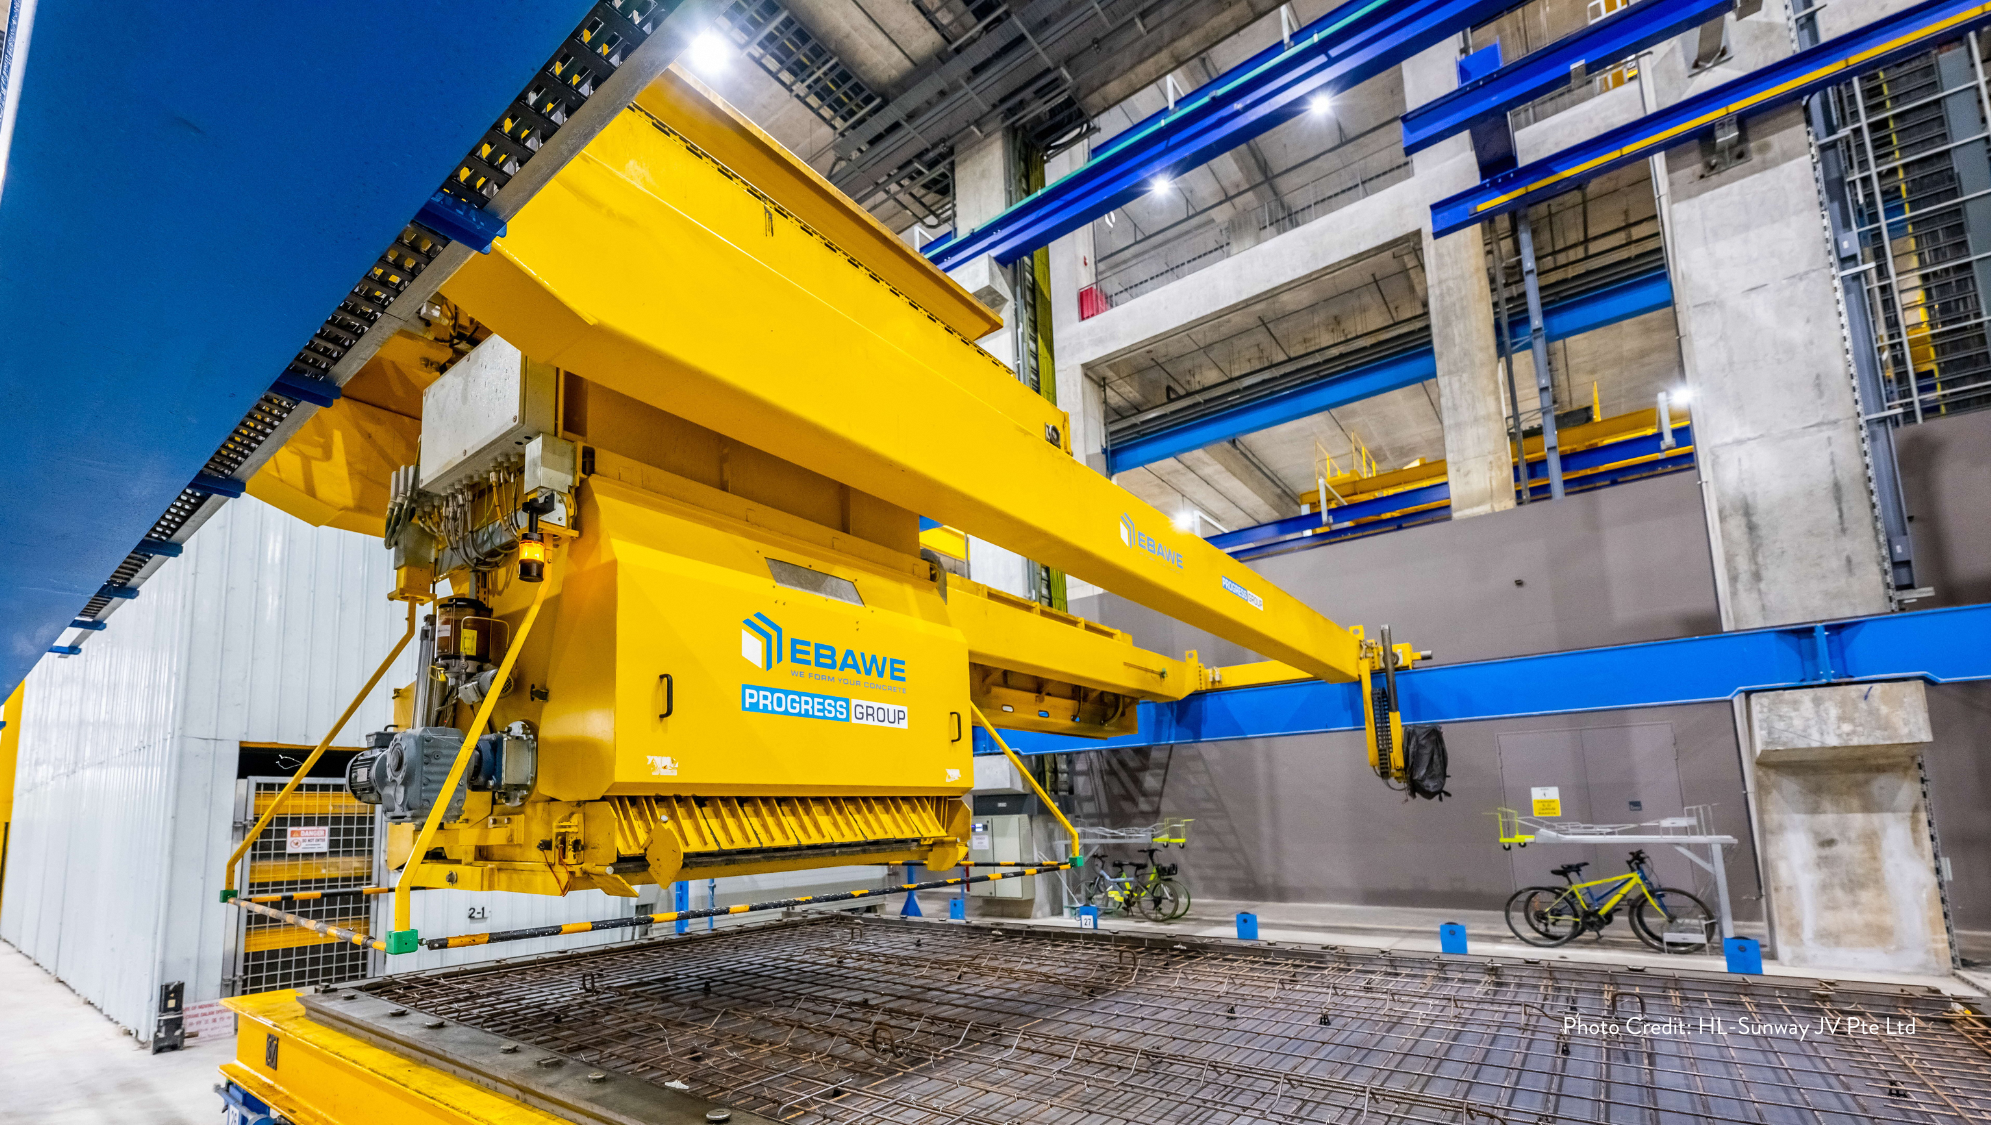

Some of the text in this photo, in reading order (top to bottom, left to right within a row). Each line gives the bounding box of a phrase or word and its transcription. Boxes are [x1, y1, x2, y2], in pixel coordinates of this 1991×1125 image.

[1138, 531, 1183, 569] EBAWE
[790, 637, 906, 682] EBAWE
[790, 669, 907, 694] WE FORM YOUR CONCRETE
[745, 688, 906, 725] PROGRESS GROUP
[467, 906, 485, 919] 2-1
[1084, 918, 1091, 926] 27
